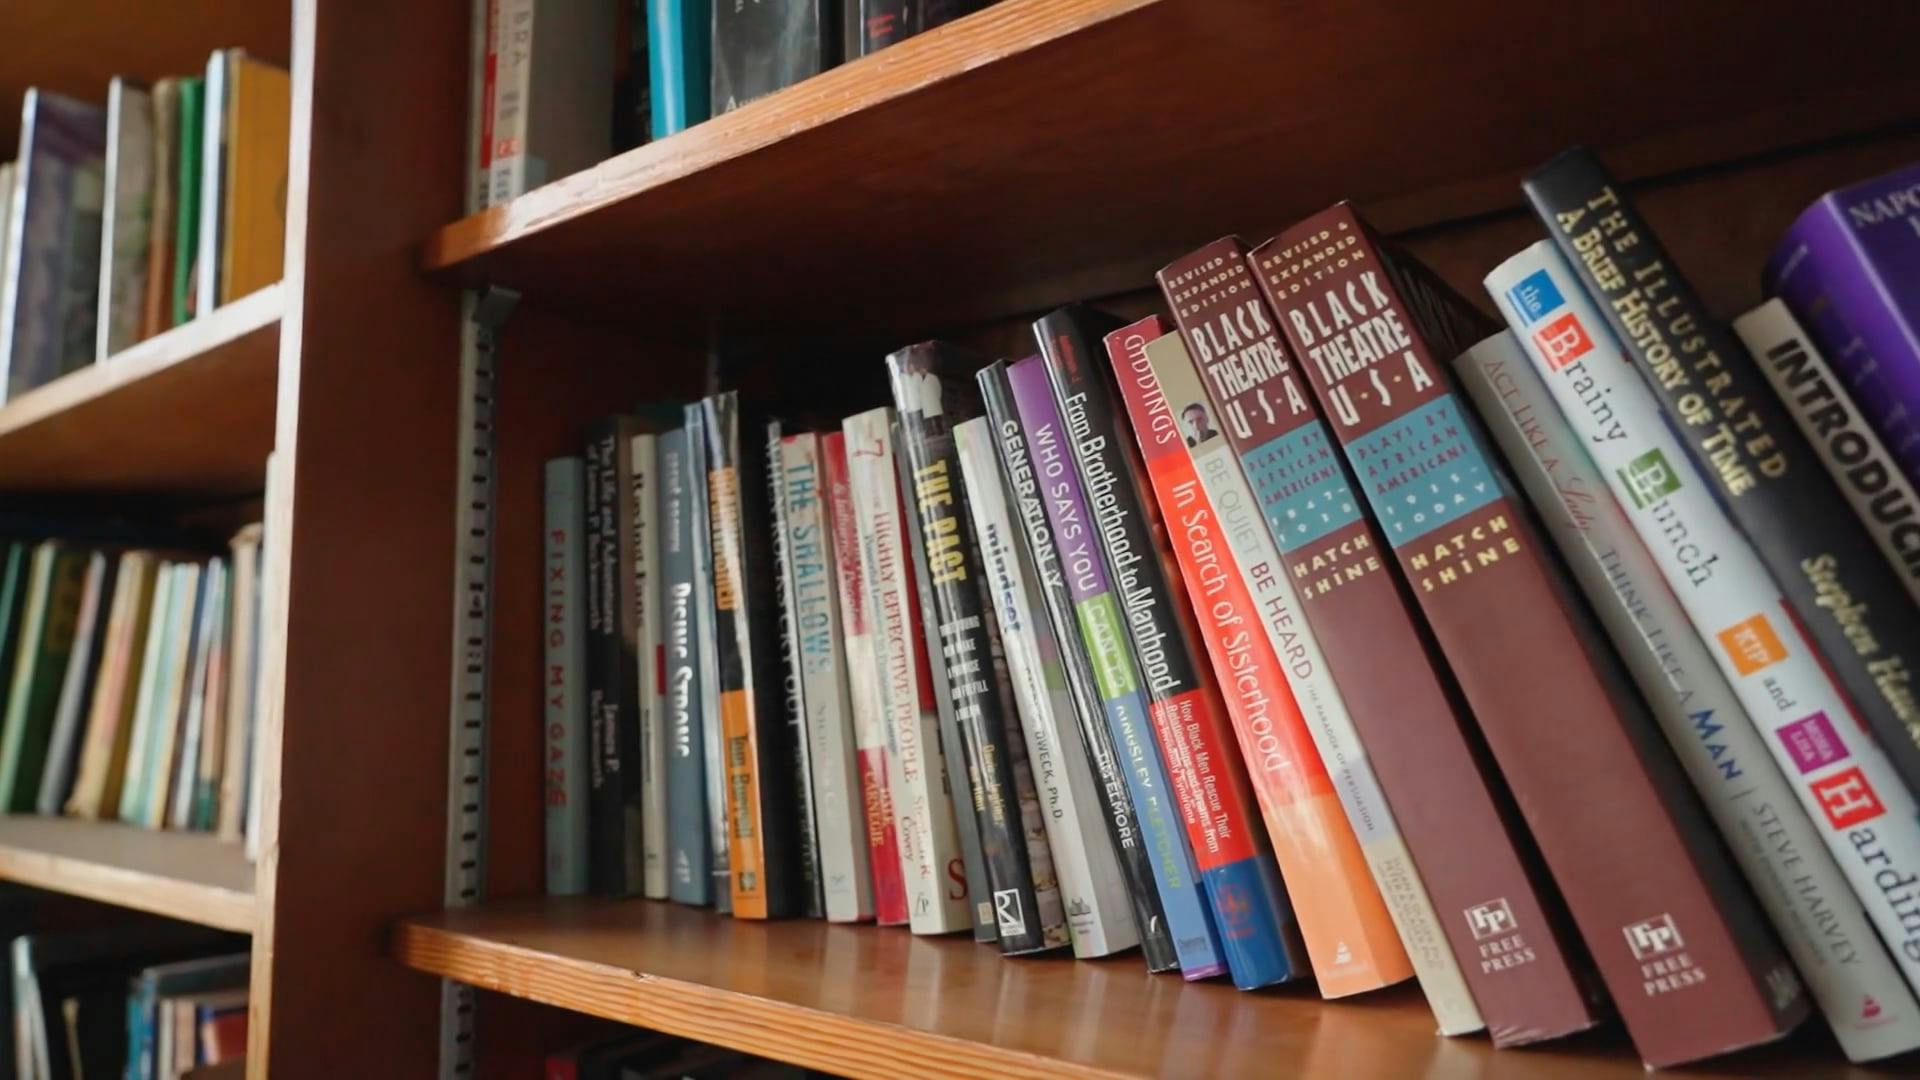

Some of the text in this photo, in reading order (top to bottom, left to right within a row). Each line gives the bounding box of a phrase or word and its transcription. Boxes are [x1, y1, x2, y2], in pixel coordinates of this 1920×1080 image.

[1168, 257, 1223, 289] REVISED
[1262, 230, 1330, 270] REVISED
[1270, 236, 1356, 284] EXPANDED
[1278, 249, 1365, 300] EDITION
[1175, 265, 1244, 303] EXPANDED
[1181, 279, 1251, 318] EDITION
[1289, 270, 1389, 347] BLACK
[1520, 282, 1547, 313] the
[1190, 300, 1271, 363] BLACK
[1309, 308, 1411, 386] THEATRE
[1556, 206, 1756, 499] A BRIEF HISTORY OF TIME
[1585, 187, 1788, 477] THE ILLUSTRATED
[1124, 333, 1177, 446] GIDDINGS
[1208, 336, 1289, 401] THEATRE
[1545, 324, 1628, 443] Brainy
[1065, 391, 1090, 441] From
[1484, 358, 1518, 402] ACT
[1511, 403, 1552, 449] LIKE
[853, 438, 884, 458] 7
[1248, 428, 1320, 472] PLAYS BY
[1357, 408, 1446, 460] PLAYS BY
[1367, 426, 1458, 478] AFRICAN
[785, 461, 817, 513] THE
[917, 459, 952, 513] THE
[1002, 421, 1055, 561] GENERATION
[1258, 448, 1328, 488] AFRICAN
[1265, 463, 1337, 505] AMERICANS
[1376, 442, 1468, 496] AMERICANS
[1034, 423, 1097, 592] WHO SAYS YOU
[1079, 435, 1142, 570] Brotherhood
[1394, 481, 1485, 532] TODAY
[872, 512, 898, 583] HIGHLY
[924, 517, 967, 585] PACT
[1206, 457, 1313, 681] BE QUIET BE HEARD
[1294, 534, 1370, 579] HATCH
[1411, 515, 1508, 571] HATCH
[1422, 537, 1521, 592] SHINE
[1119, 566, 1138, 592] to
[1304, 556, 1381, 600] SHINE
[1802, 553, 1880, 655] Stephen
[884, 592, 908, 697] EFFECTIVE
[1127, 584, 1181, 692] Manhood
[1172, 480, 1292, 773] In Search of Sisterhood
[1734, 624, 1771, 664] KIP
[546, 528, 565, 805] FIXING MY GAZE
[1600, 550, 1651, 623] THINK
[1688, 708, 1744, 781] MAN
[1762, 676, 1798, 712] and
[1115, 705, 1152, 789] KINGSLEY
[1179, 698, 1231, 840] How Black Men Rescue Their
[867, 772, 884, 848] CARNEGIE
[1047, 787, 1066, 823] Ph.D.
[1105, 776, 1134, 849] ELMORE
[1172, 773, 1196, 825] Syndrome
[1342, 768, 1375, 832] PERSUASION
[900, 816, 916, 863] Covey
[1203, 829, 1220, 854] from
[1753, 801, 1806, 870] STEVE
[1793, 873, 1862, 967] HARVEY
[1479, 934, 1525, 958] FREE
[1481, 947, 1536, 974] PRESS
[1641, 953, 1694, 979] FREE
[1643, 968, 1706, 997] PRESS
